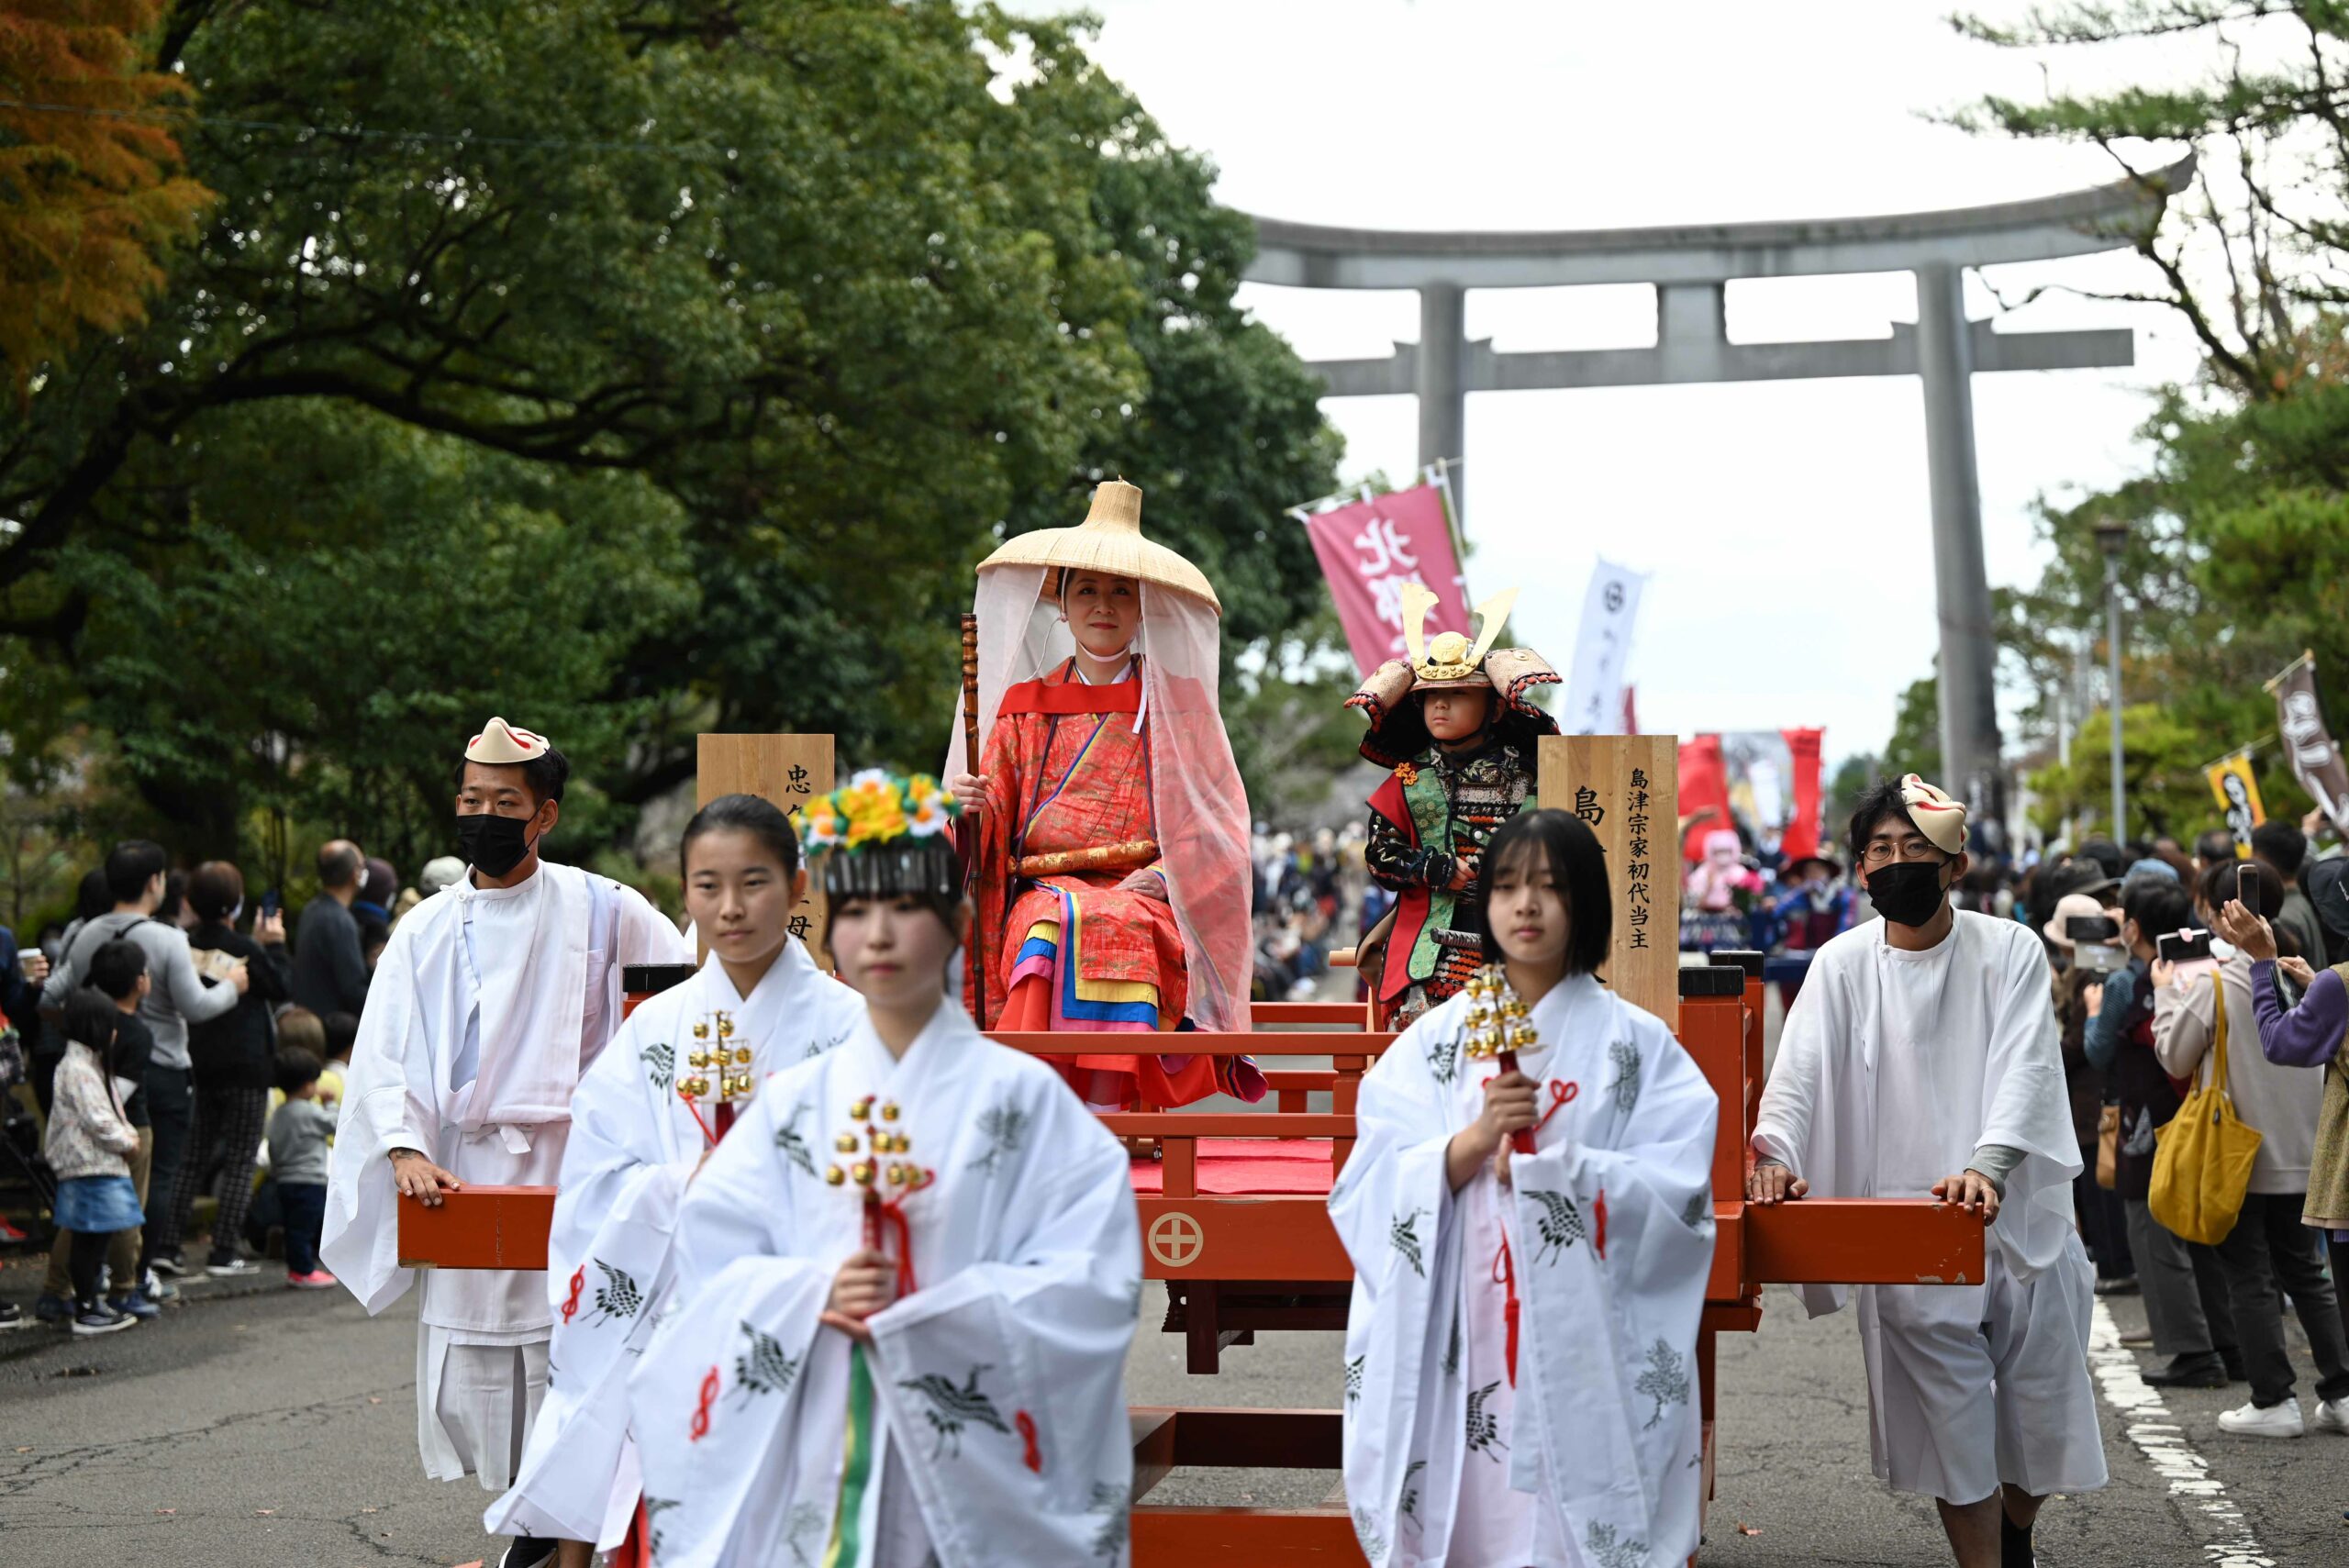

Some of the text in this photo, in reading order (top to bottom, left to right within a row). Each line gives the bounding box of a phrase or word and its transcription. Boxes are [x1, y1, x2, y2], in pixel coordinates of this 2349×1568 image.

[1627, 767, 1651, 949] 島津宗家初代当主
